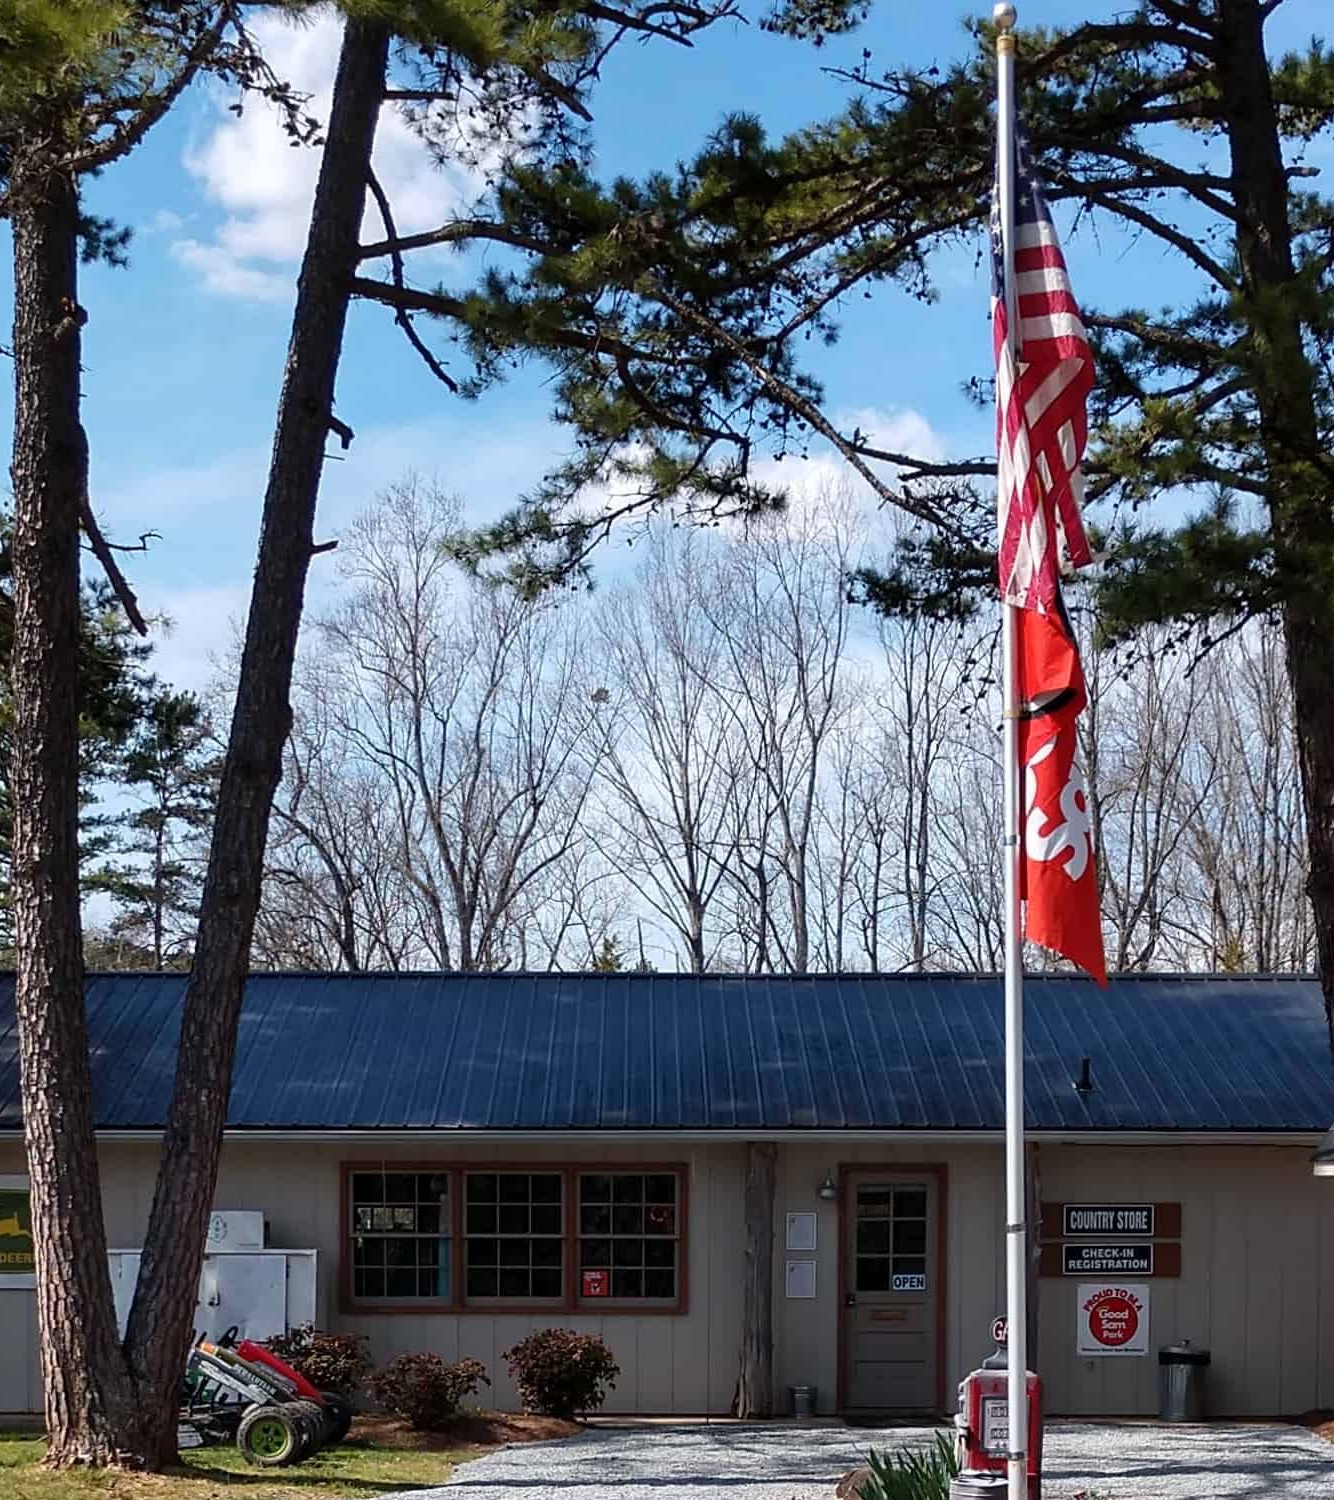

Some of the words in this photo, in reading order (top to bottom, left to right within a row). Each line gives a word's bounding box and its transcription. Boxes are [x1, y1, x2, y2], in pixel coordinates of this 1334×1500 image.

[1070, 1210, 1115, 1230] COUNTRY
[1116, 1210, 1148, 1230] STORE
[1082, 1248, 1135, 1258] CHECK-IN
[1068, 1259, 1148, 1269] REGISTRATION
[894, 1276, 924, 1289] OPEN
[1083, 1288, 1113, 1312] PROUD
[1114, 1288, 1128, 1298] TO
[1099, 1307, 1129, 1319] Good
[1101, 1319, 1126, 1329] Sam
[1103, 1329, 1124, 1339] Park
